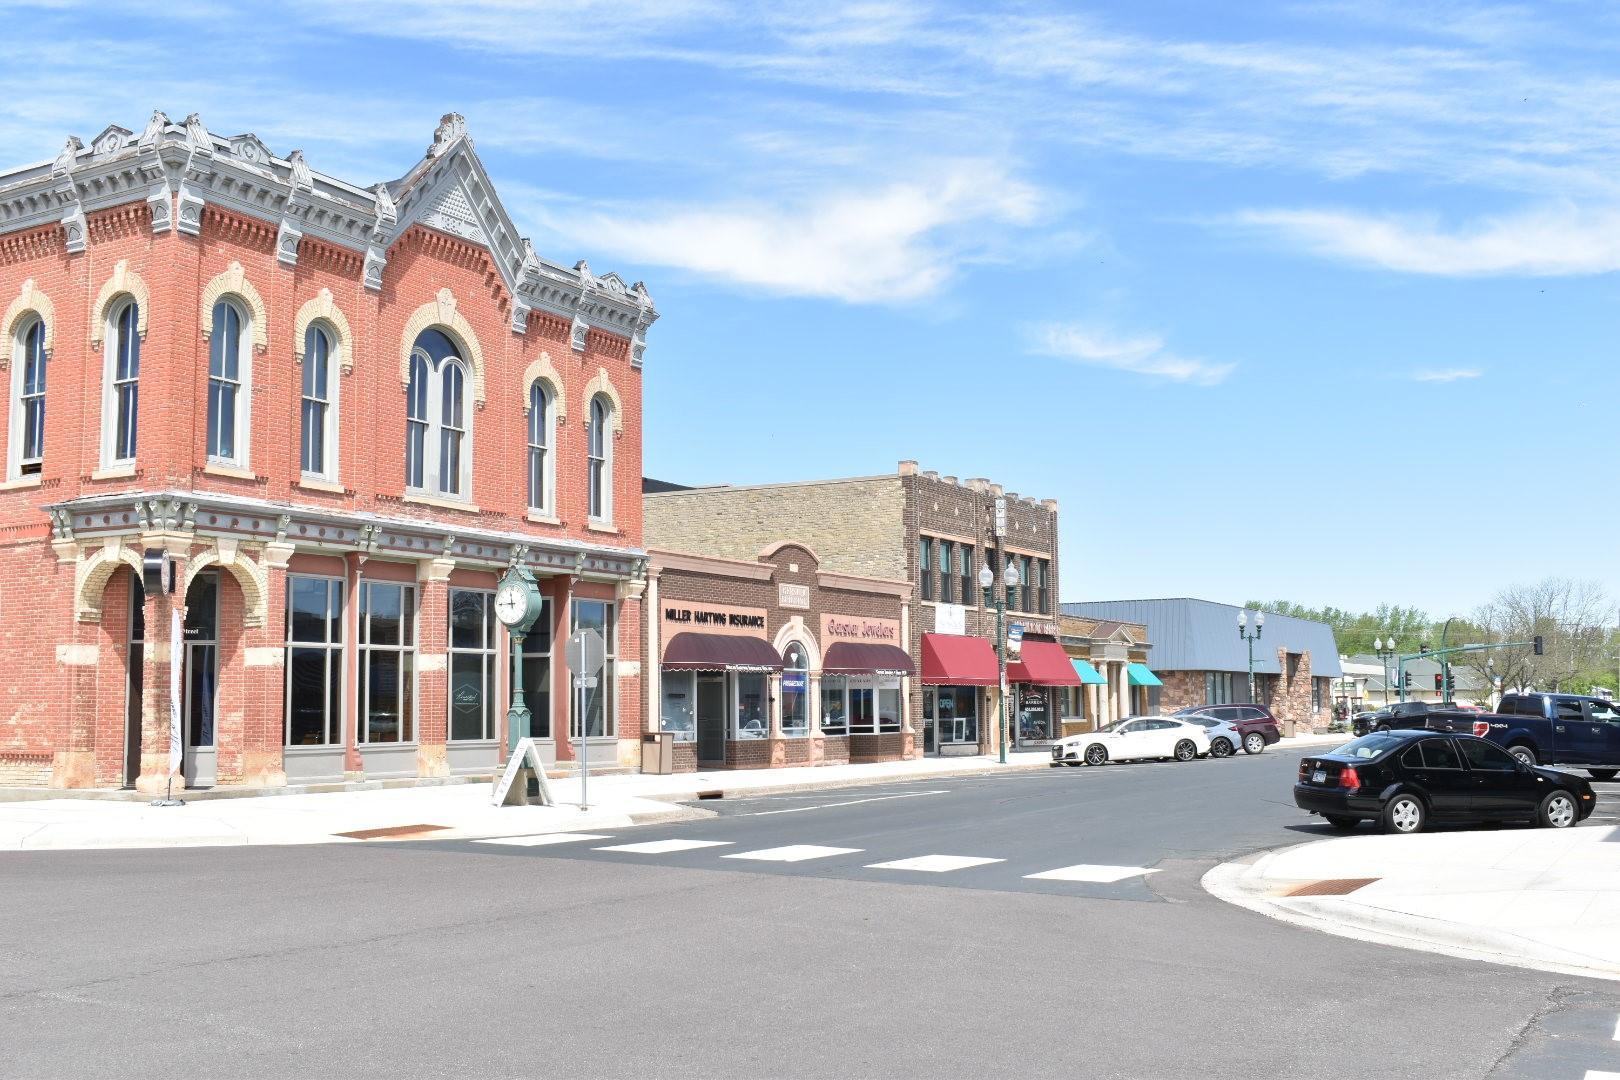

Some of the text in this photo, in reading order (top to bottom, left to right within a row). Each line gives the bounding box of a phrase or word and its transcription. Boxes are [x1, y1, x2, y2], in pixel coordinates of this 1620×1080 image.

[665, 608, 764, 628] MILLER HARTWIG INSURANCE
[861, 621, 894, 639] Jewelers
[940, 698, 954, 709] OPEN
